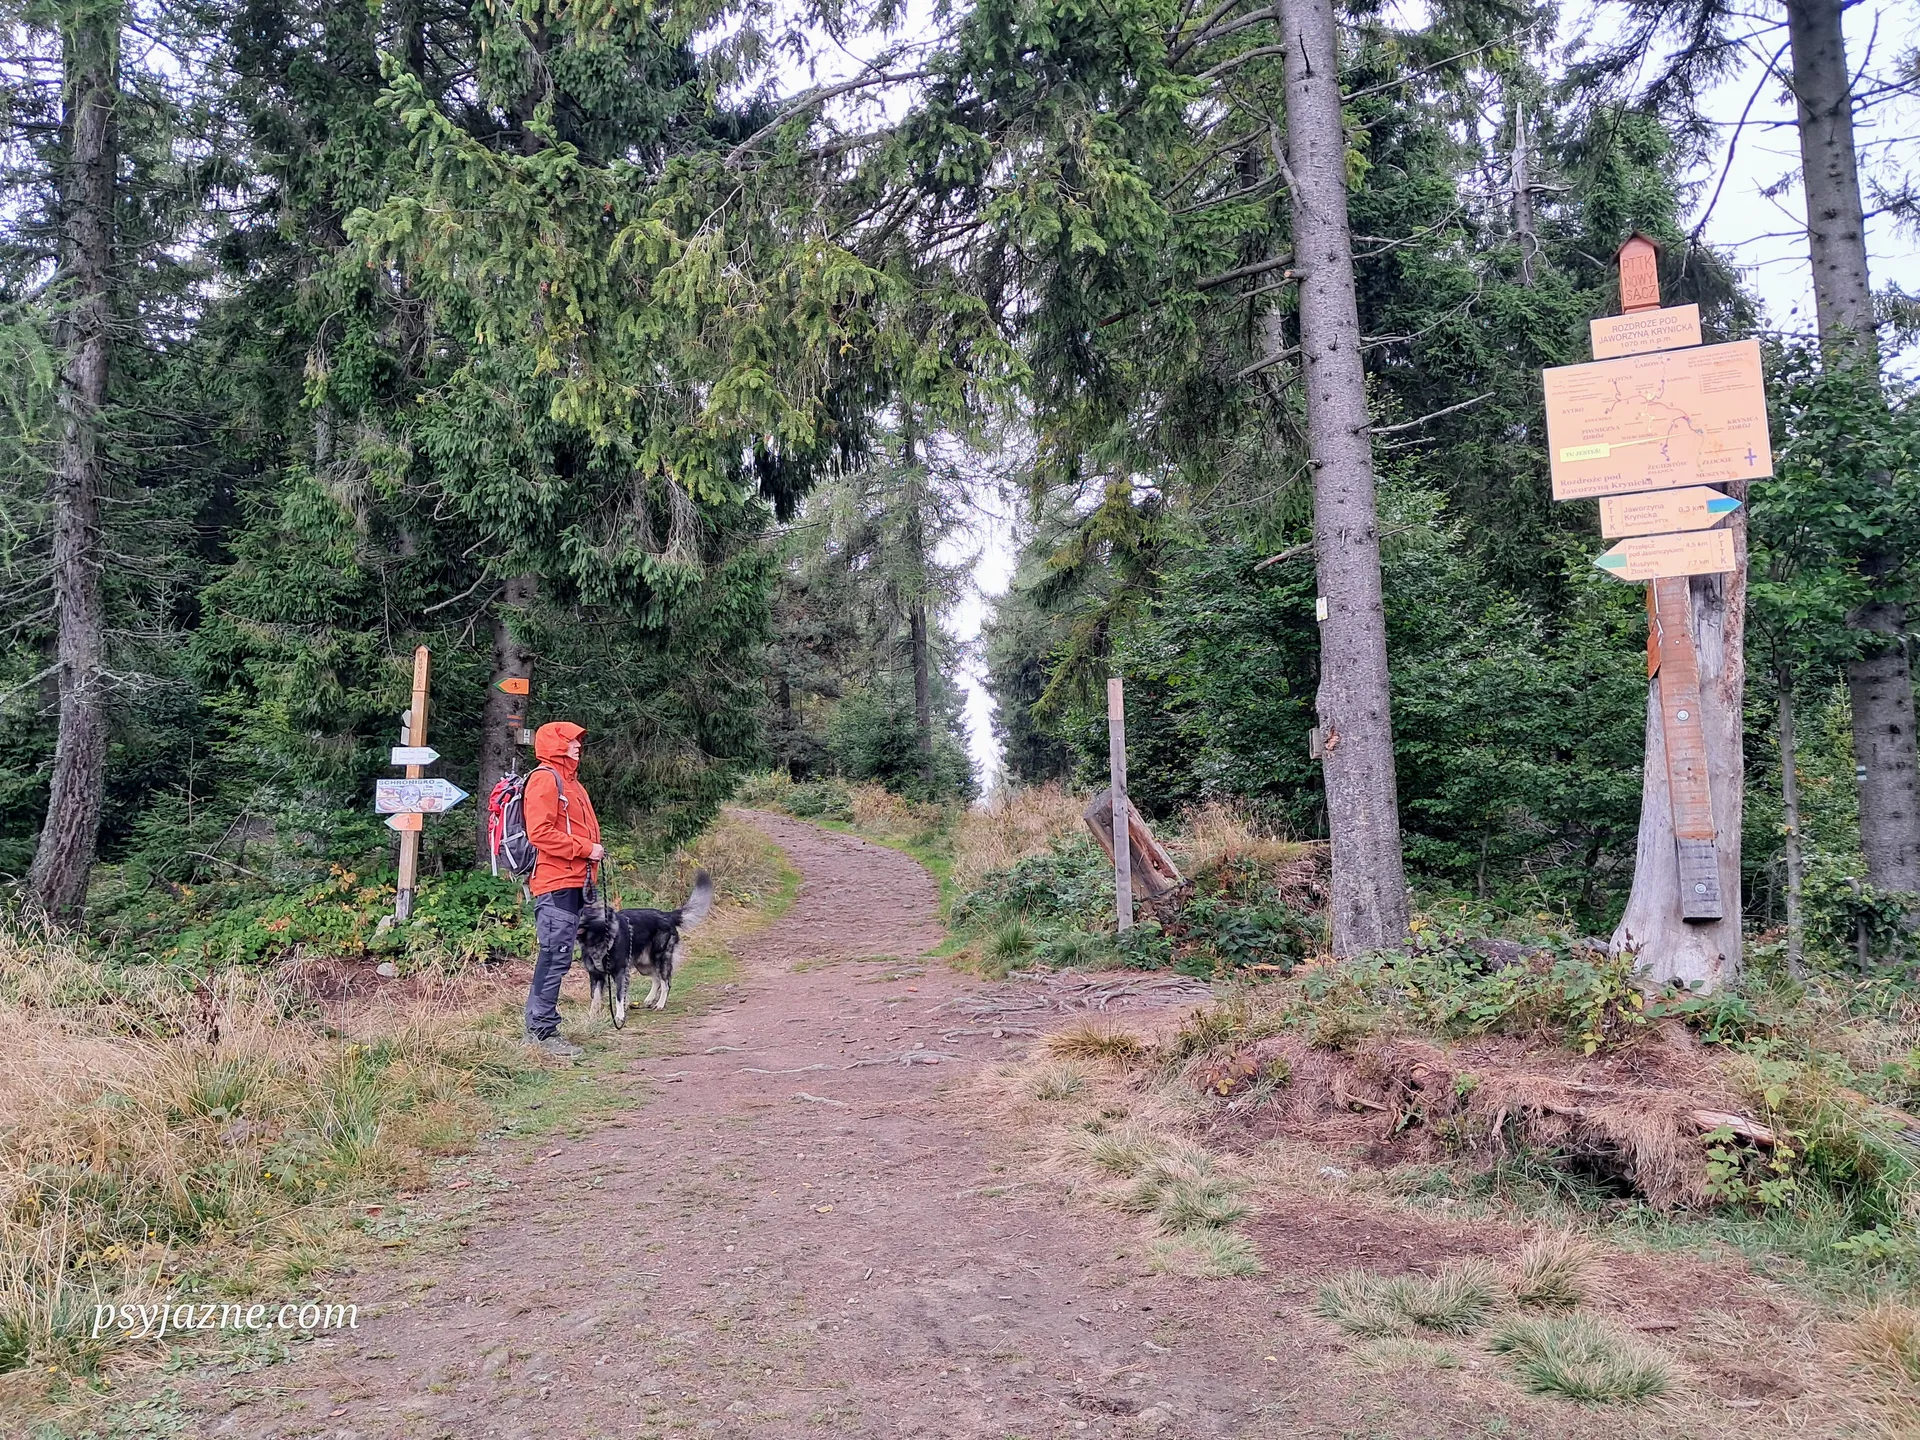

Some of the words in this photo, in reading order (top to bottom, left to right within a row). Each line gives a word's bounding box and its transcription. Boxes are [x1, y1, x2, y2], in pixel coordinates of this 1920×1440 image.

[1622, 254, 1653, 272] PTTK
[1624, 271, 1655, 288] NOWY
[1660, 316, 1678, 326] POD
[1599, 329, 1650, 344] JAWORZYNĄ
[1652, 323, 1694, 336] KRYNICKĄ
[1621, 340, 1638, 348] 1070
[1604, 473, 1621, 483] pod
[1560, 483, 1609, 495] Jaworzyną
[1624, 504, 1664, 513] Jaworzyna
[1624, 512, 1658, 521] Krynicka
[1628, 550, 1640, 558] pod
[1630, 560, 1658, 569] Muszyna
